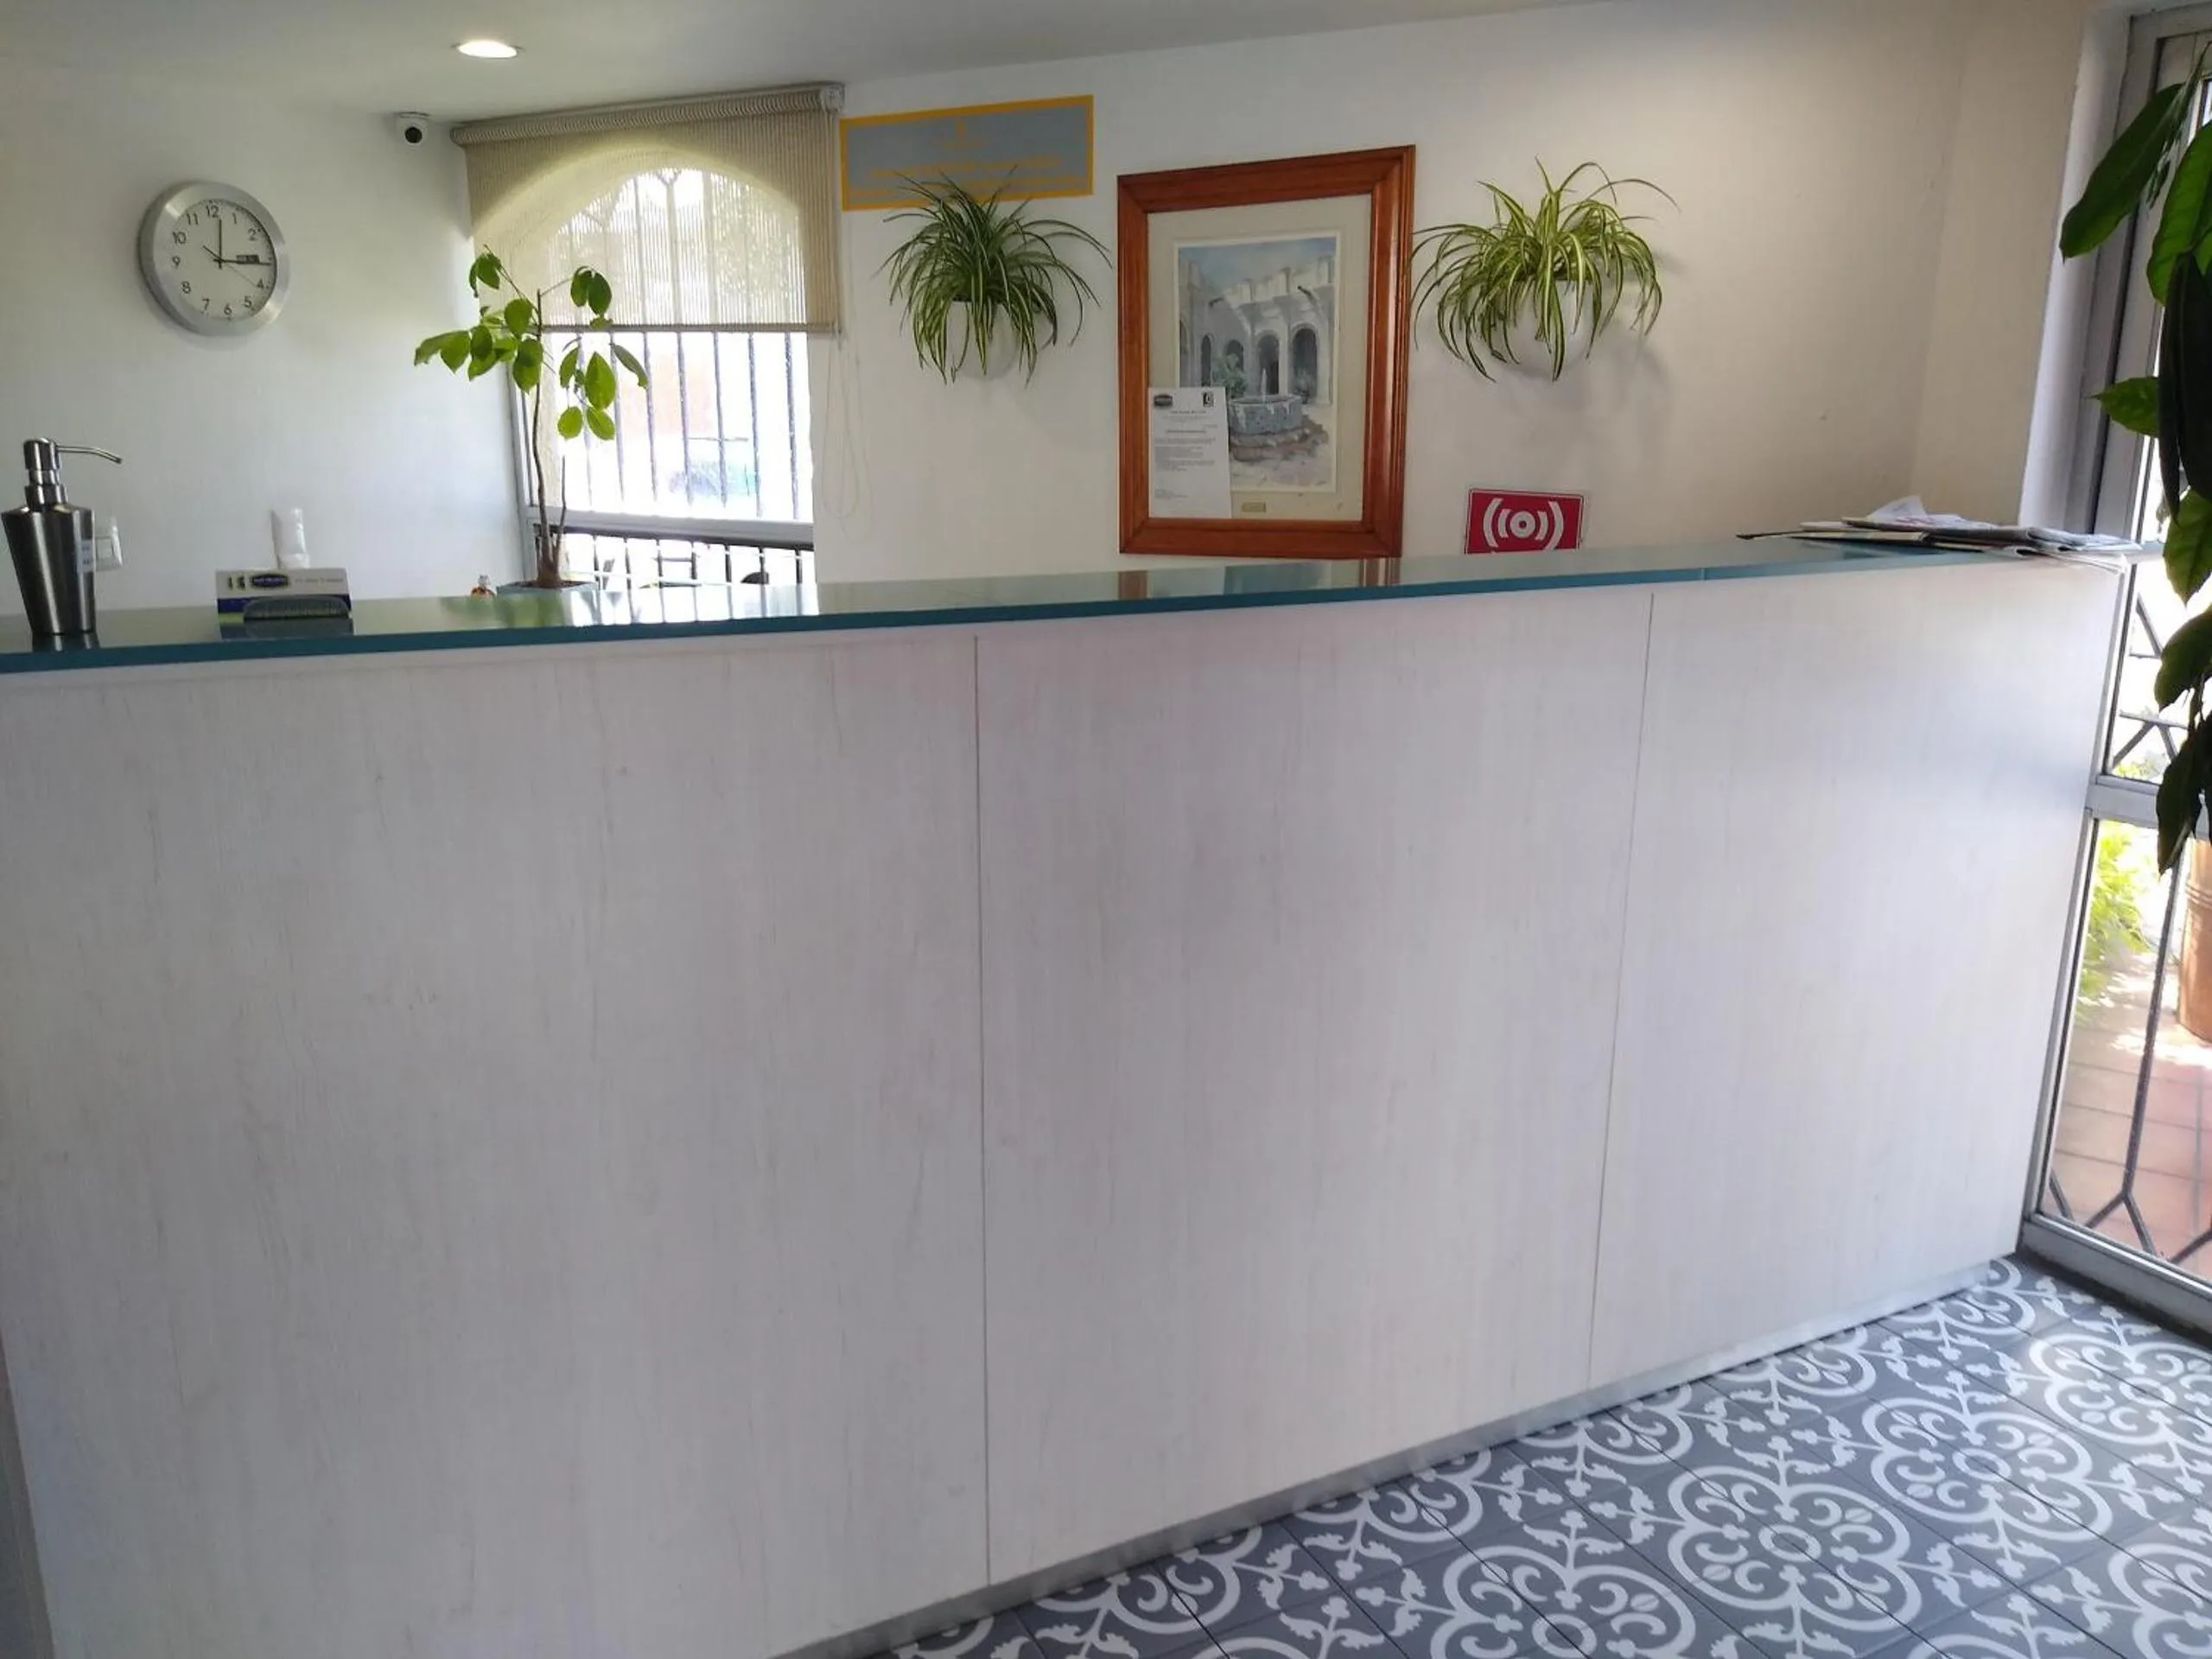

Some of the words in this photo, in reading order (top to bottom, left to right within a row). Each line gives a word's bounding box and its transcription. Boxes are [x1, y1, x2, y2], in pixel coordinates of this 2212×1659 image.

[206, 205, 219, 218] 12
[187, 213, 199, 226] 11
[172, 231, 187, 245] 10
[248, 228, 257, 241] 2
[172, 256, 181, 269] 9
[181, 281, 191, 294] 8
[202, 298, 210, 310] 7
[243, 296, 252, 308] 5
[224, 304, 232, 315] 6
